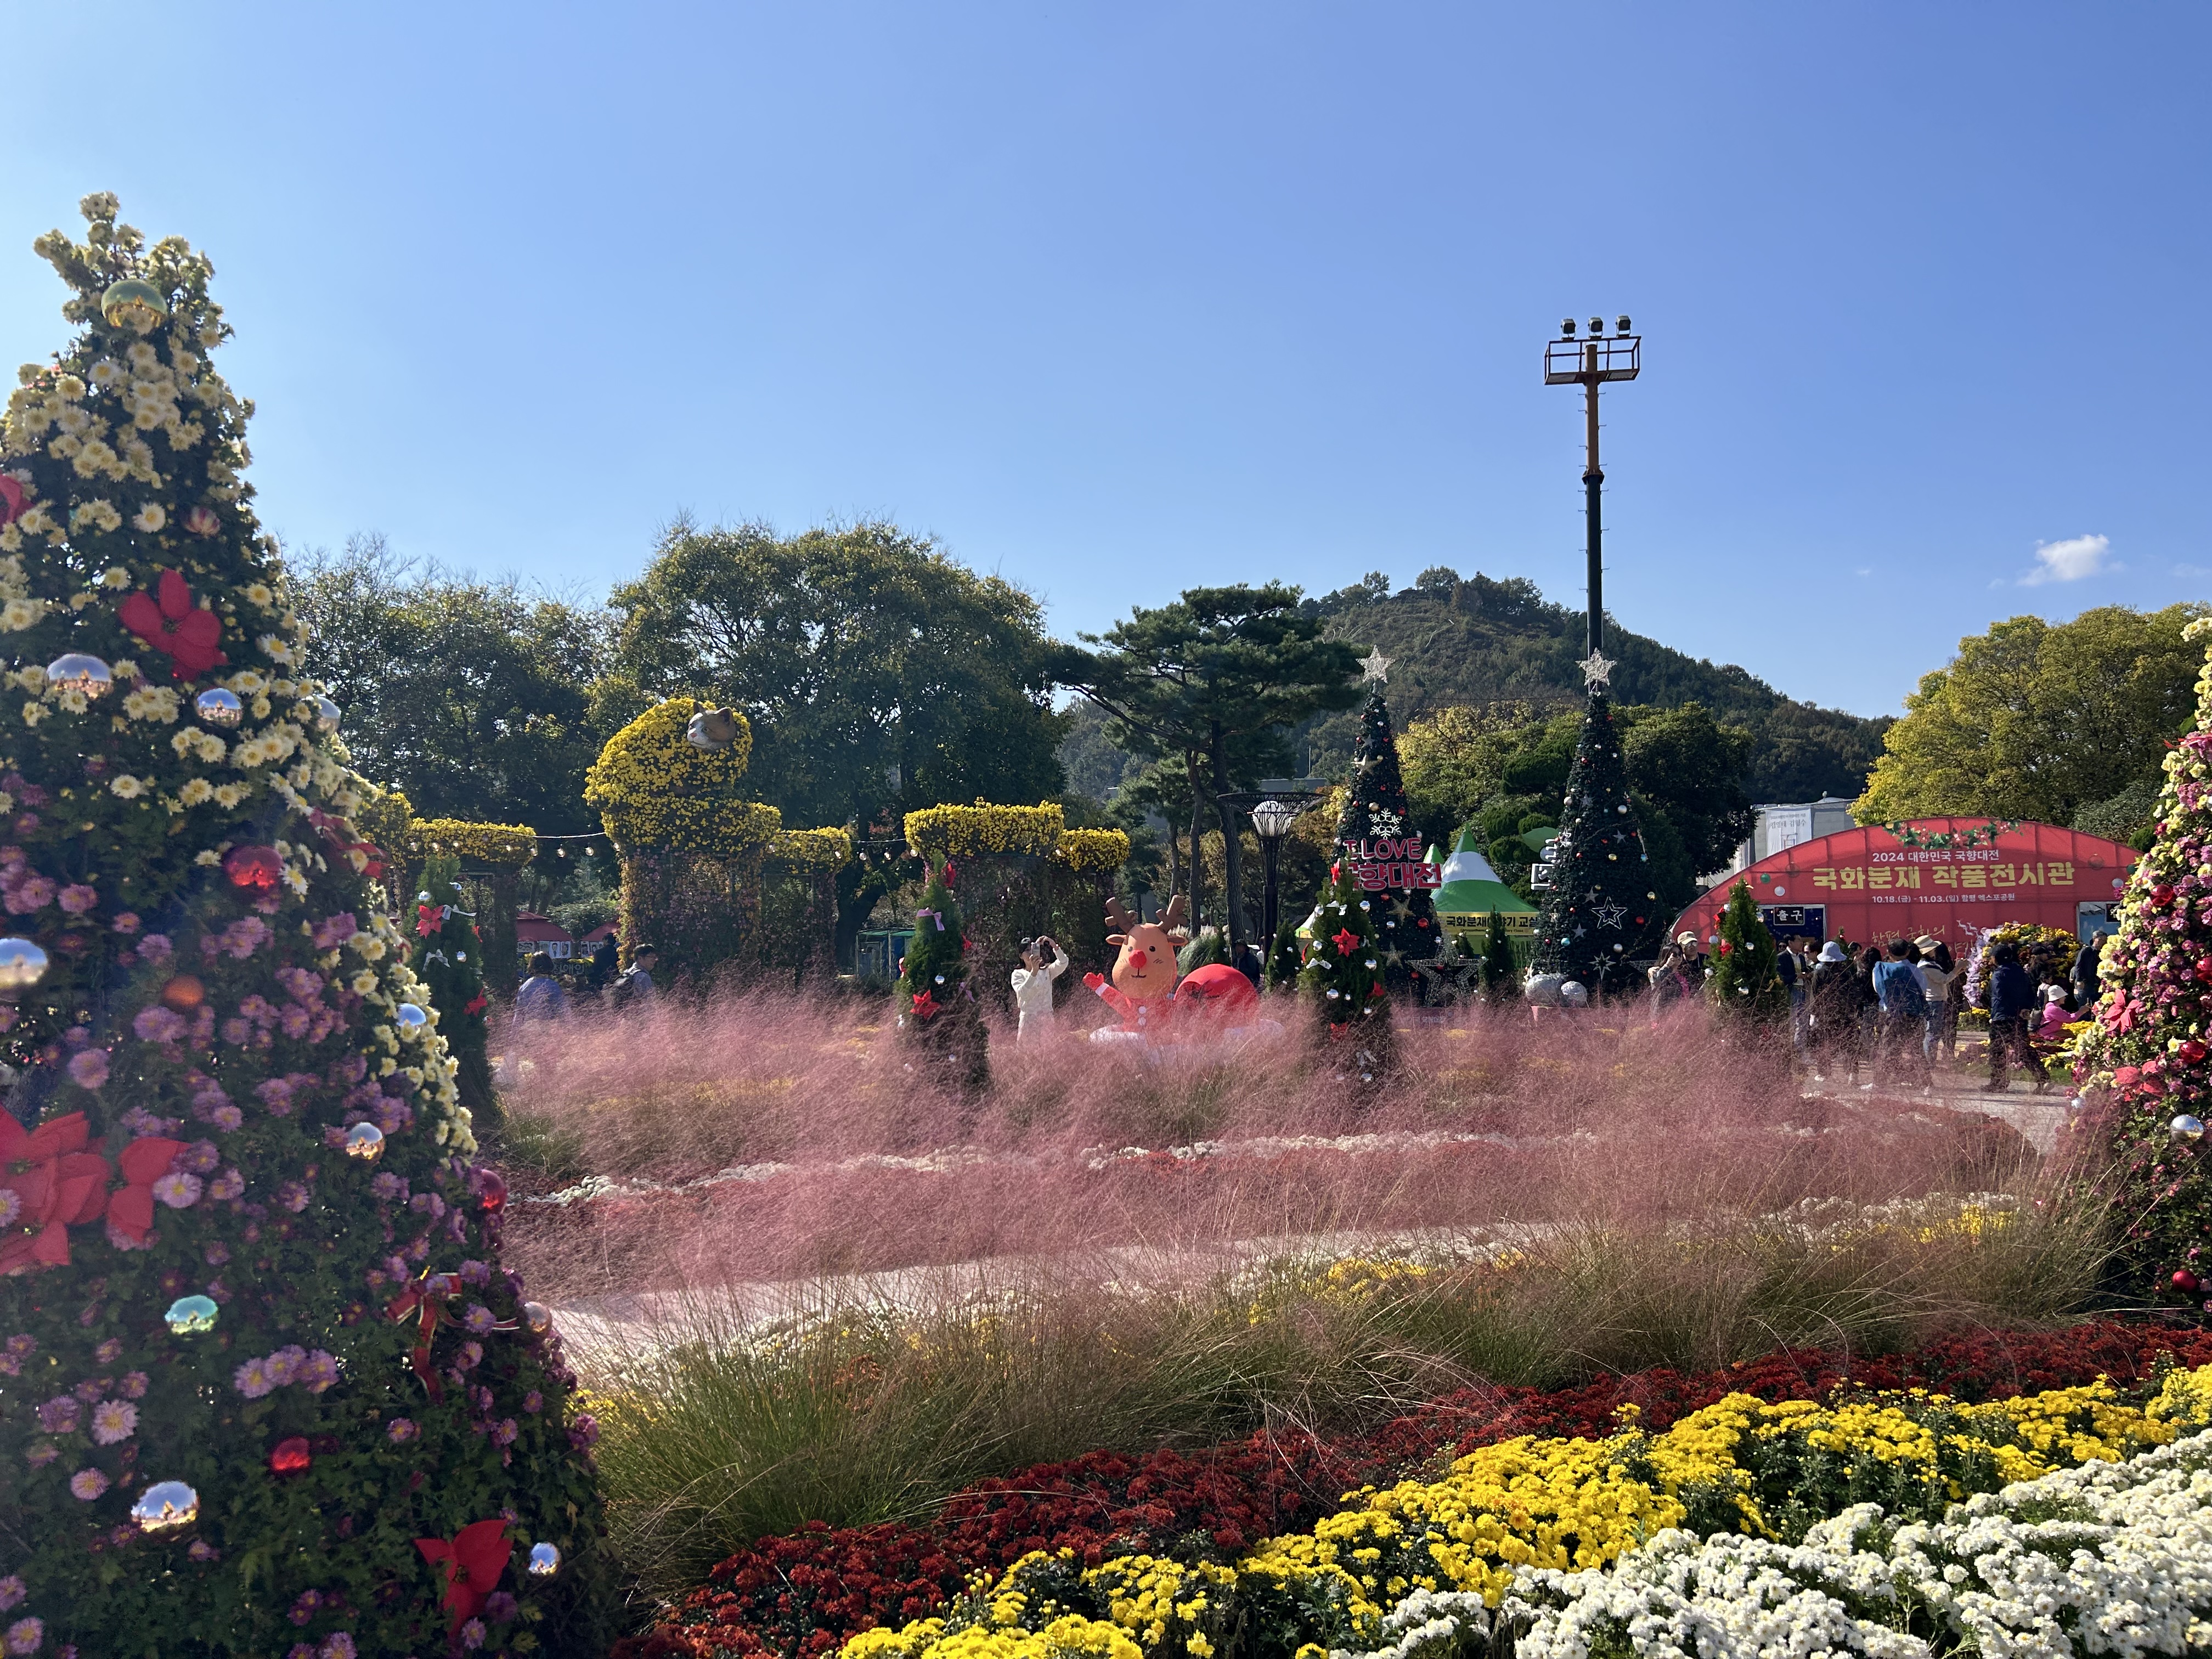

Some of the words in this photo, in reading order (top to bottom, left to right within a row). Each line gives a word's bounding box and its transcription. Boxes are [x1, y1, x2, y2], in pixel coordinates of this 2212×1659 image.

[1361, 838, 1423, 860] LOVE
[1872, 852, 1905, 862] 2024
[1908, 850, 1951, 862] 대한민국
[1954, 849, 2000, 862] 국향대전
[1813, 866, 1921, 890] 국화분재
[1932, 861, 2075, 888] 작품전시관
[1919, 895, 1959, 903] 11.03.(일)
[1978, 893, 2015, 902] 엑스포공원
[1776, 910, 1803, 921] 출구
[1446, 916, 1516, 927] 국화분재기
[1518, 916, 1538, 928] 교실
